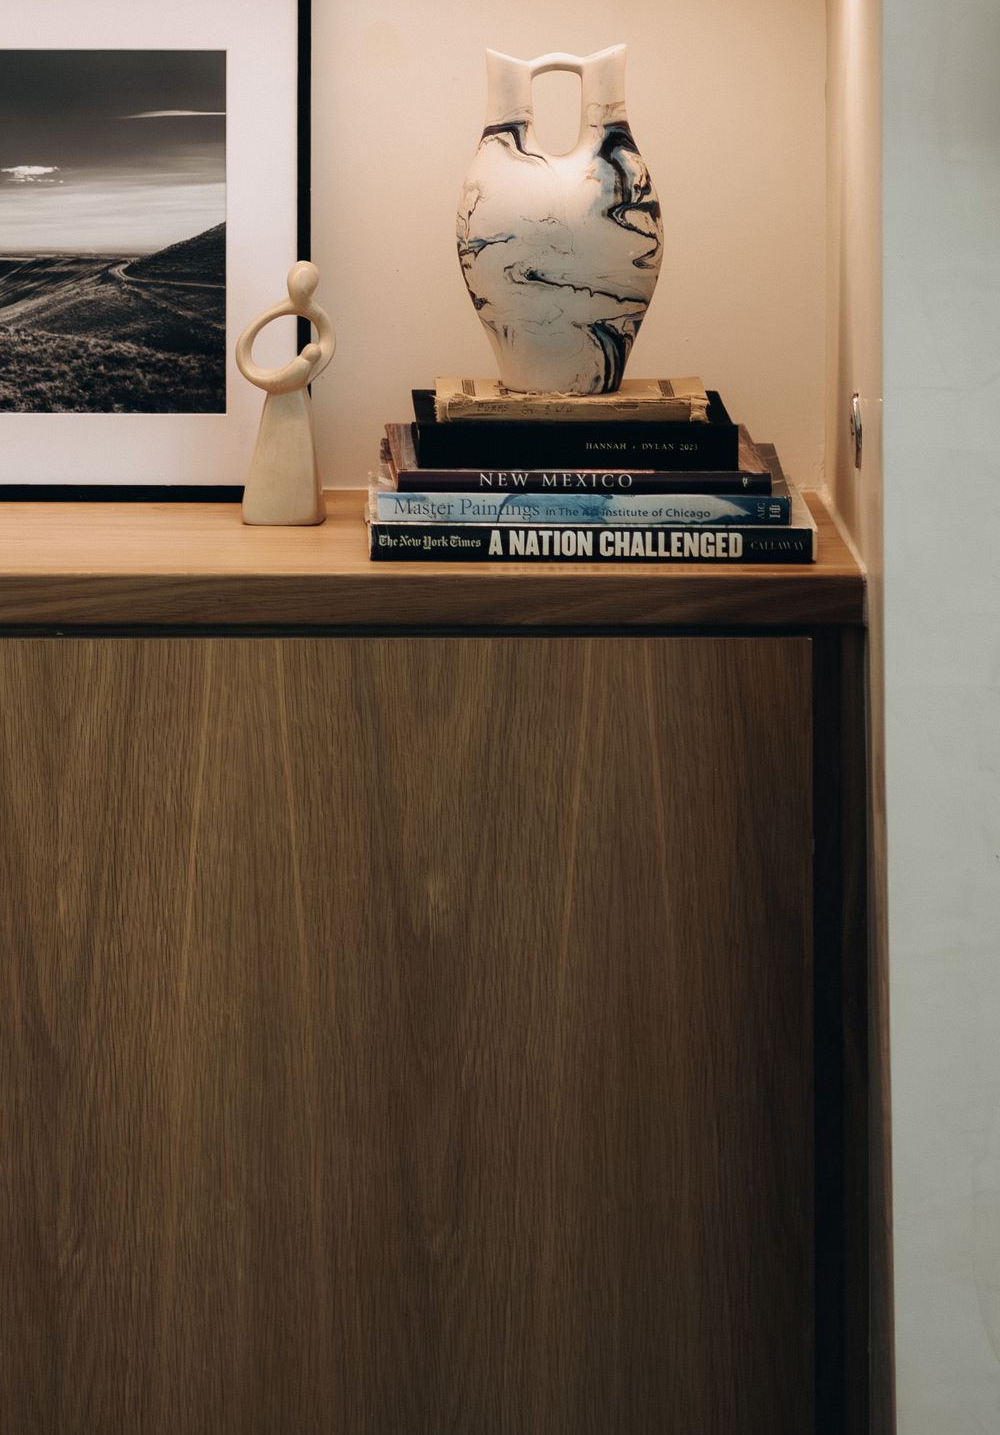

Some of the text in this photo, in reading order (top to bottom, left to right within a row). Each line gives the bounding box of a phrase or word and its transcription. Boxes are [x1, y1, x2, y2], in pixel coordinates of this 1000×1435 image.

[585, 442, 627, 450] HANNAH
[641, 443, 674, 451] DYLAN
[479, 472, 633, 488] NEW MEXICO
[394, 498, 455, 516] Master
[460, 498, 540, 521] Paintings
[545, 507, 556, 517] in
[558, 507, 579, 517] The
[602, 507, 649, 517] Institute
[651, 507, 664, 518] of
[665, 507, 711, 519] Chicago
[378, 534, 399, 547] The
[399, 534, 422, 547] New
[422, 534, 449, 550] York
[449, 534, 482, 548] Times
[488, 530, 504, 556] A
[508, 530, 593, 557] NATION
[599, 530, 743, 558] CHALLENGED
